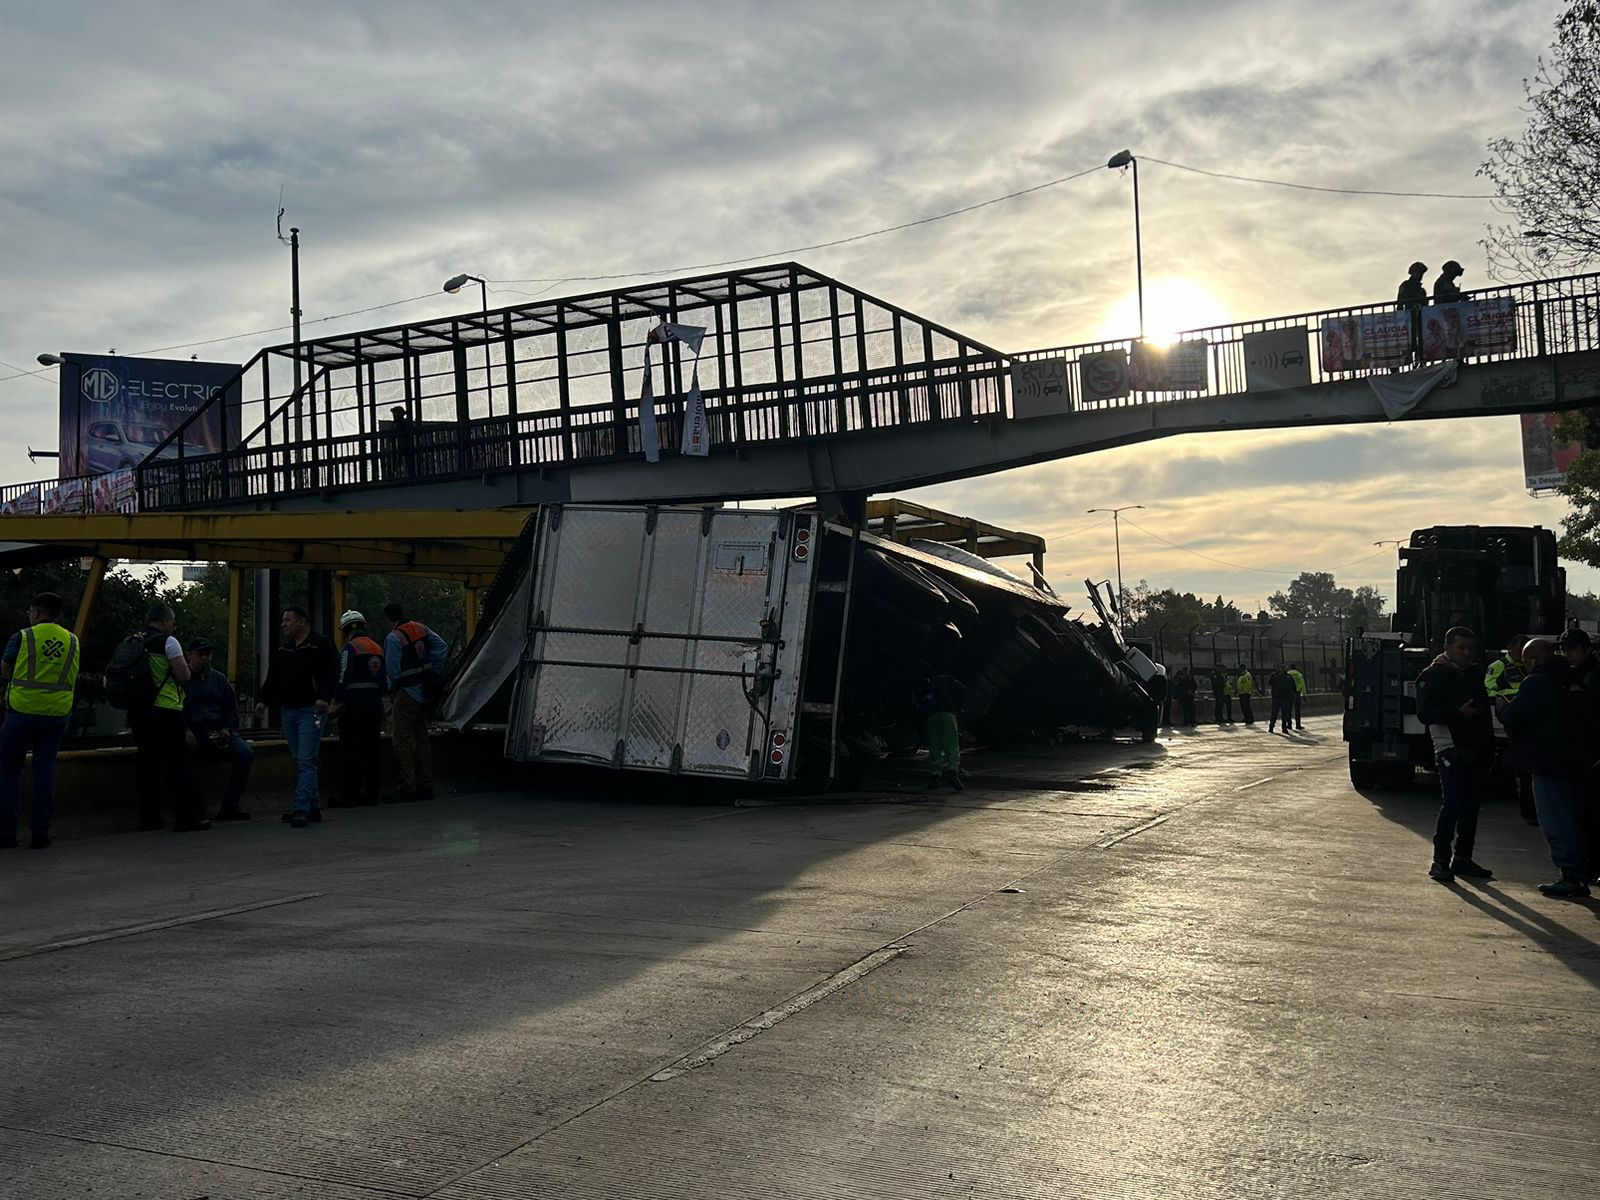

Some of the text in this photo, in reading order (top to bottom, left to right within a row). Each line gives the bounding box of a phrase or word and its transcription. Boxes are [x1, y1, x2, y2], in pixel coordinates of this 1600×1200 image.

[1466, 312, 1514, 323] CLAUDIA
[1364, 324, 1409, 336] CLAUDIA
[83, 370, 116, 400] MG
[692, 395, 702, 435] morena
